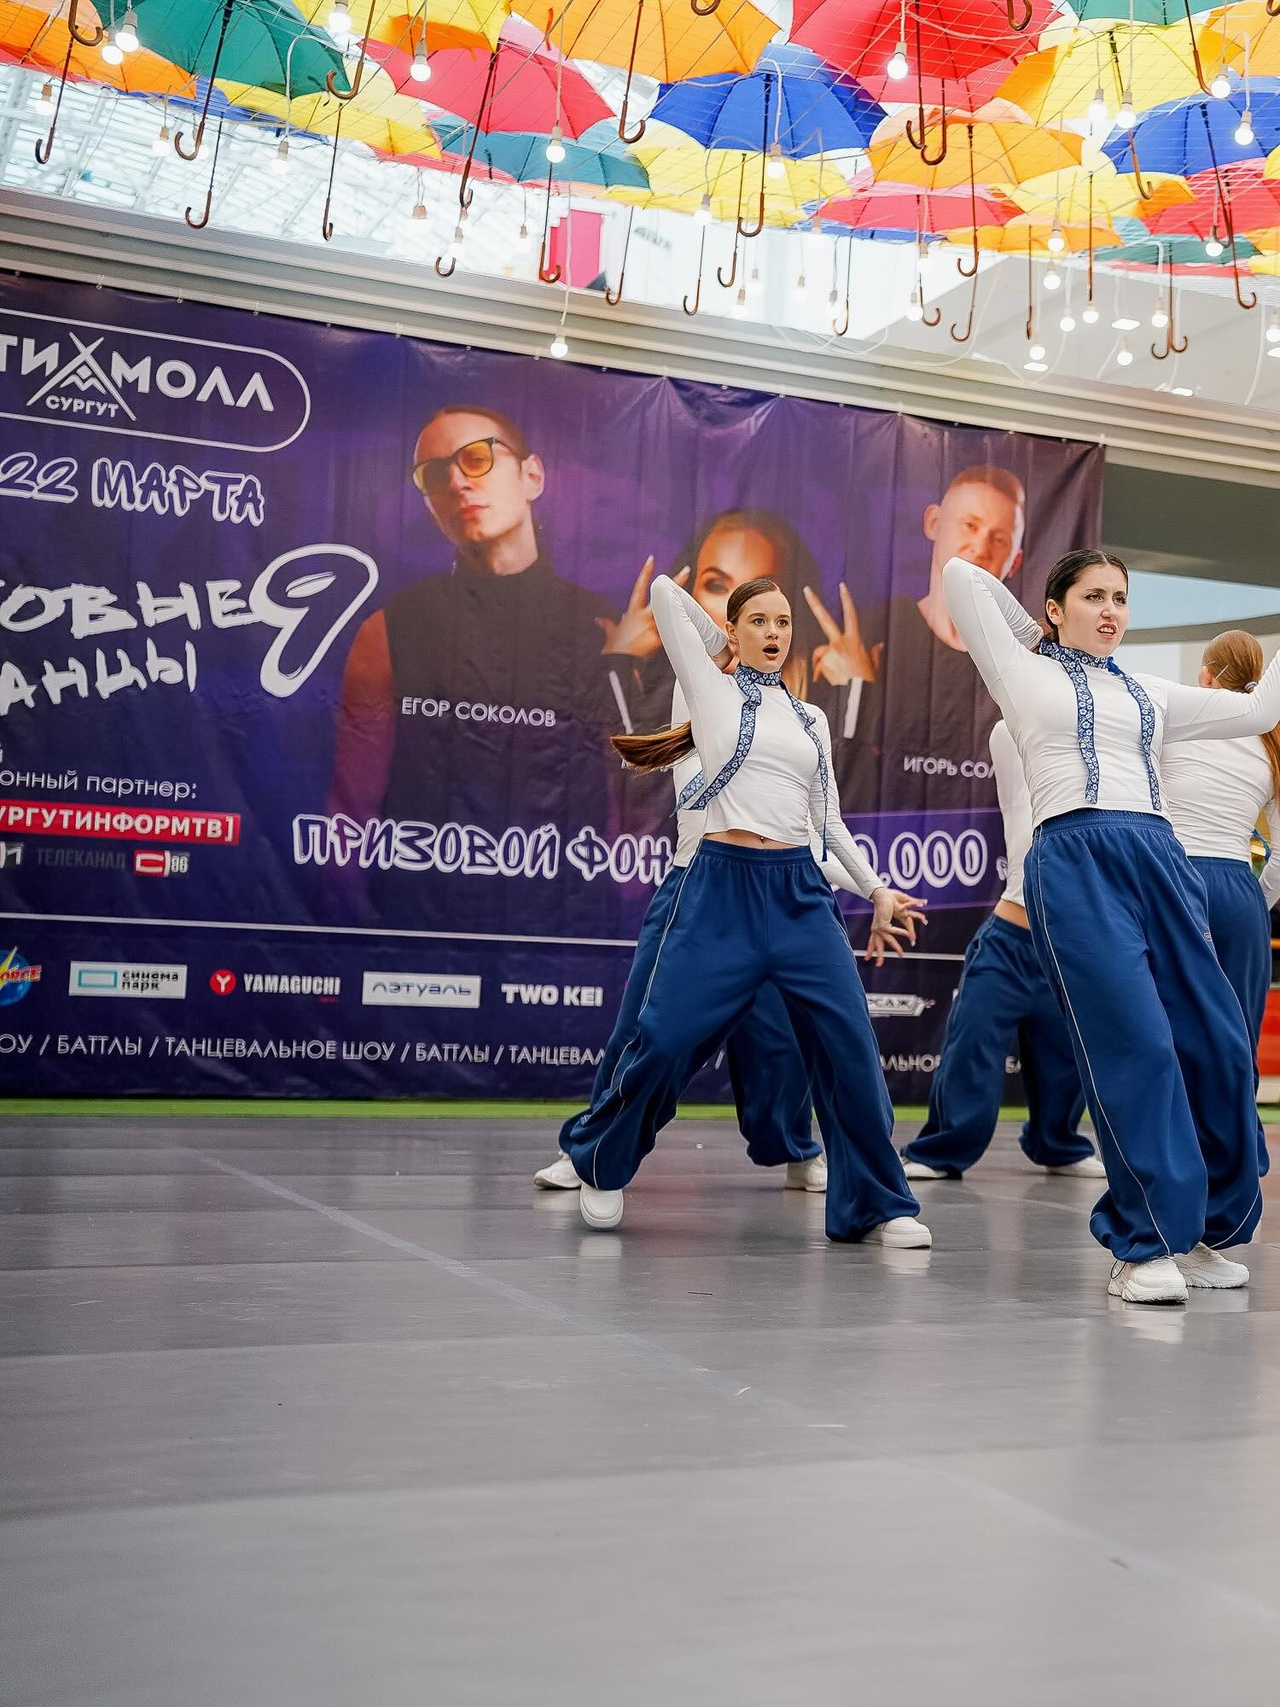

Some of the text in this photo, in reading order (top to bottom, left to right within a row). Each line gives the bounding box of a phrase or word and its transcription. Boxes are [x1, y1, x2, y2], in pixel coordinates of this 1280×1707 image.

[111, 350, 275, 412] МОЛЛ
[45, 395, 119, 418] СУРГУТ
[0, 452, 265, 526] 22 МАРТА
[0, 579, 262, 639] ОВЫЕ
[402, 697, 557, 727] ЕГОР СОКОЛОВ
[903, 755, 957, 776] ИГОРЬ
[86, 776, 197, 801] партнер:
[292, 813, 674, 886] ПРИЗОВОЙ ФОН
[121, 980, 160, 993] парк
[501, 984, 604, 1007] TWO KEI
[57, 1034, 142, 1056] БАТТЛЫ
[165, 1036, 338, 1060] ТАНЦЕВАЛЬНОЕ
[342, 1040, 396, 1061] ШОУ
[415, 1042, 490, 1064] БАТТЛЫ
